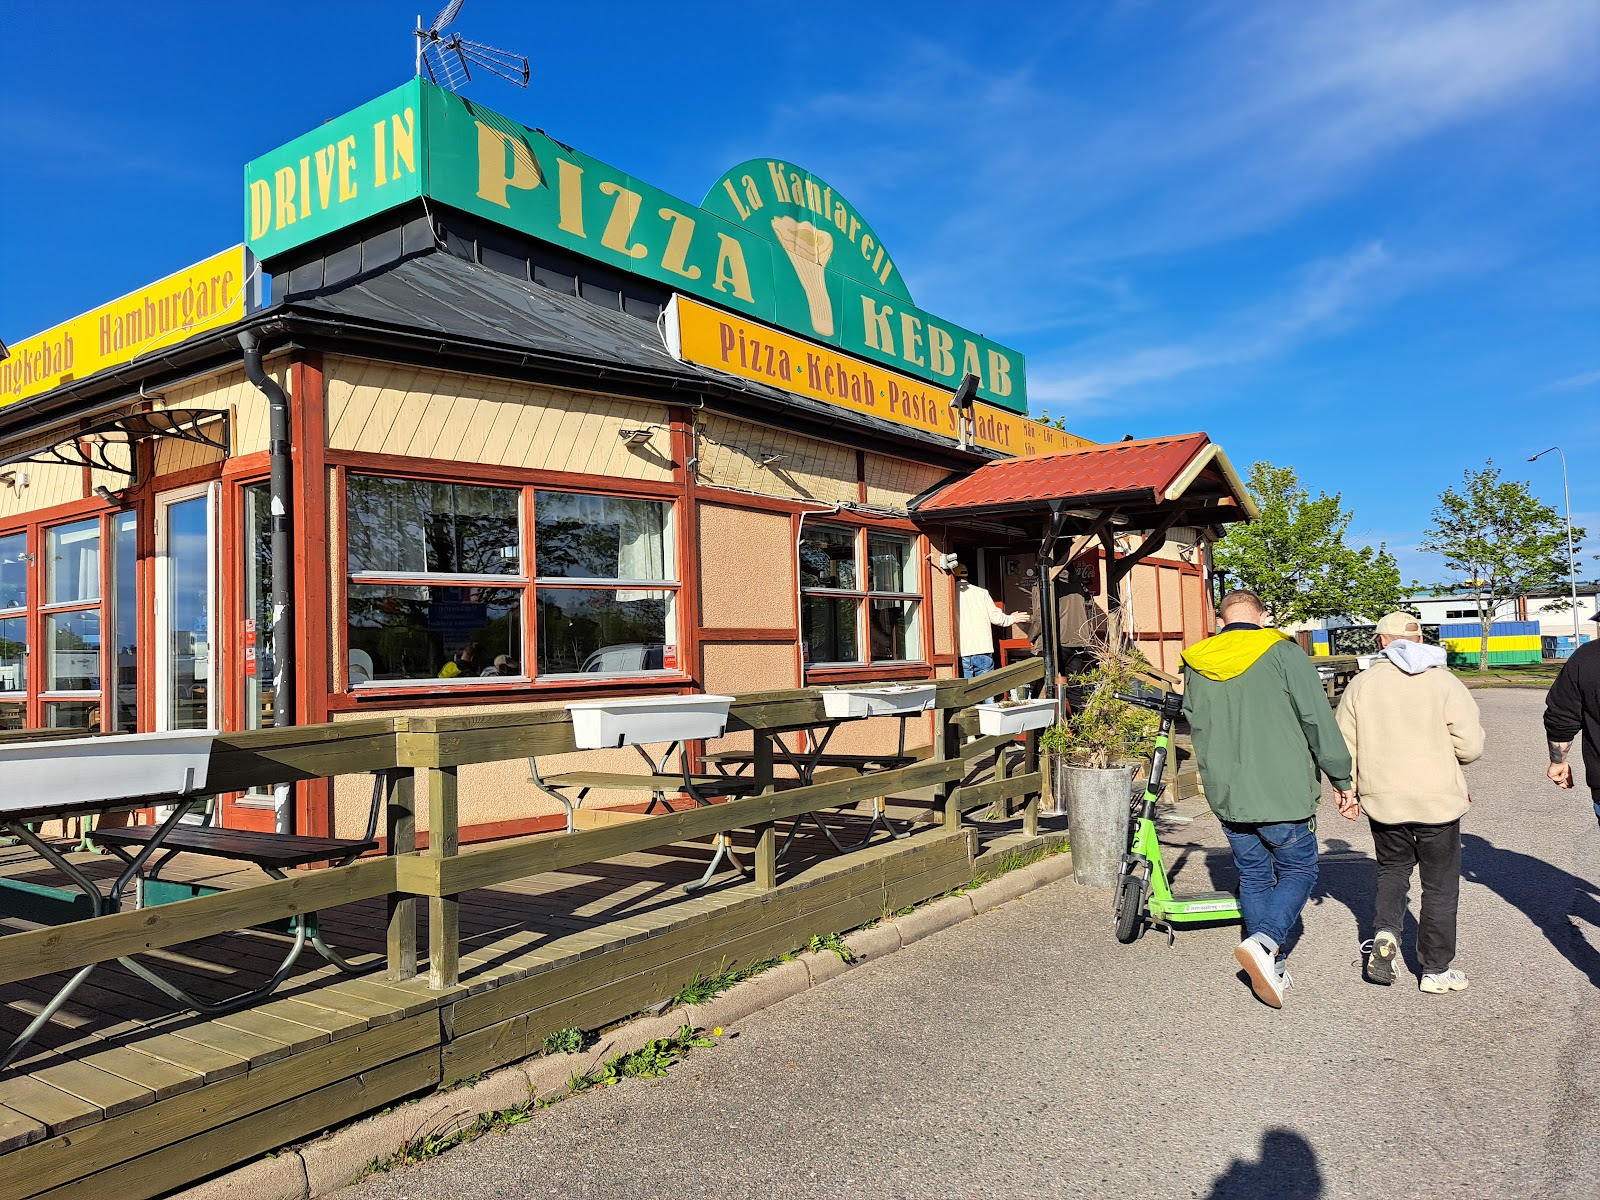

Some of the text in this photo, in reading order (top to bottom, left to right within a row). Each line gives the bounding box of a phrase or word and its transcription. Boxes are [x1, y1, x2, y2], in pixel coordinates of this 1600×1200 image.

[250, 107, 416, 241] DRIVE IN
[723, 161, 893, 286] La Kantarell
[99, 270, 234, 357] Hamburgare
[474, 120, 1012, 397] PIZZA KEBAB
[719, 321, 792, 382] Pizza
[807, 352, 875, 407] Kebab
[889, 379, 938, 427] Pasta
